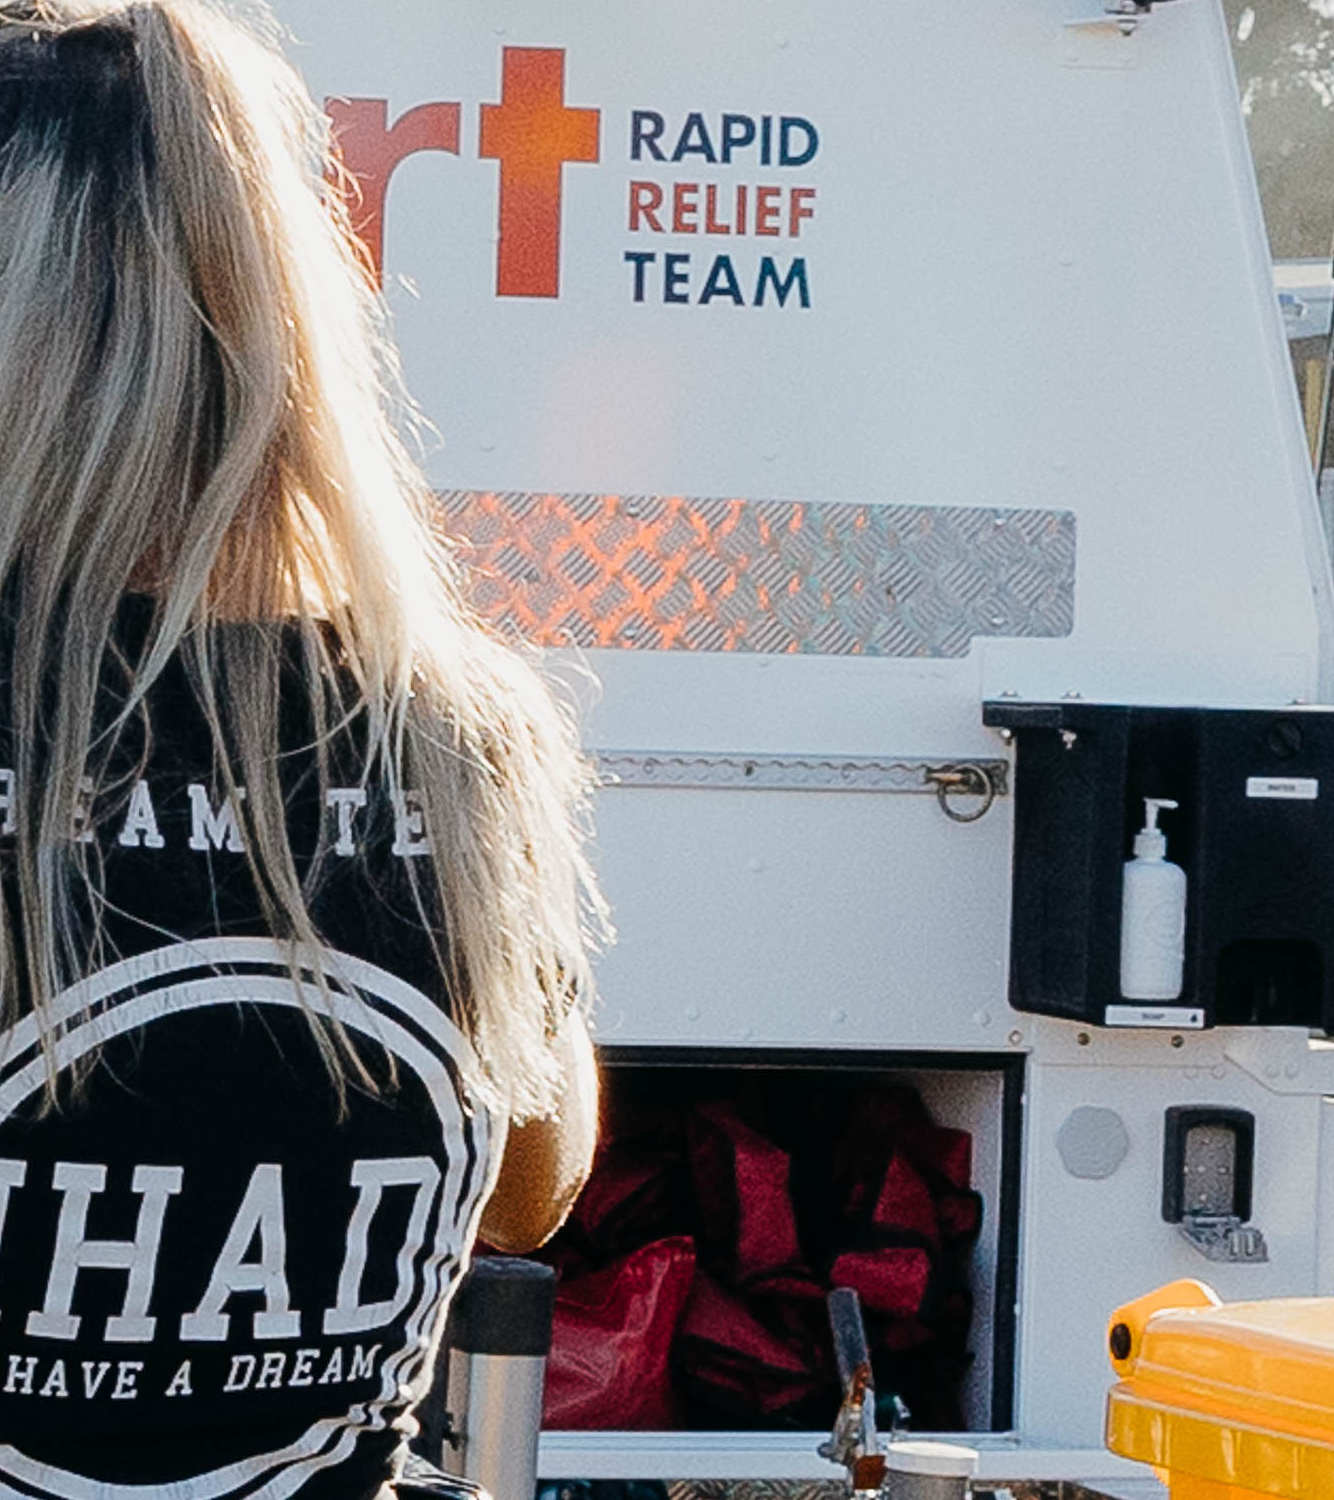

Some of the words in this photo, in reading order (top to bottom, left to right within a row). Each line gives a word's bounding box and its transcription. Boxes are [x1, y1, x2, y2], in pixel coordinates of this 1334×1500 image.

[630, 110, 819, 166] RAPID
[628, 181, 817, 238] RELIEF
[624, 251, 811, 308] TEAM
[3, 1357, 148, 1401] HAVE
[165, 1360, 196, 1398] A
[223, 1343, 384, 1396] DREAM
